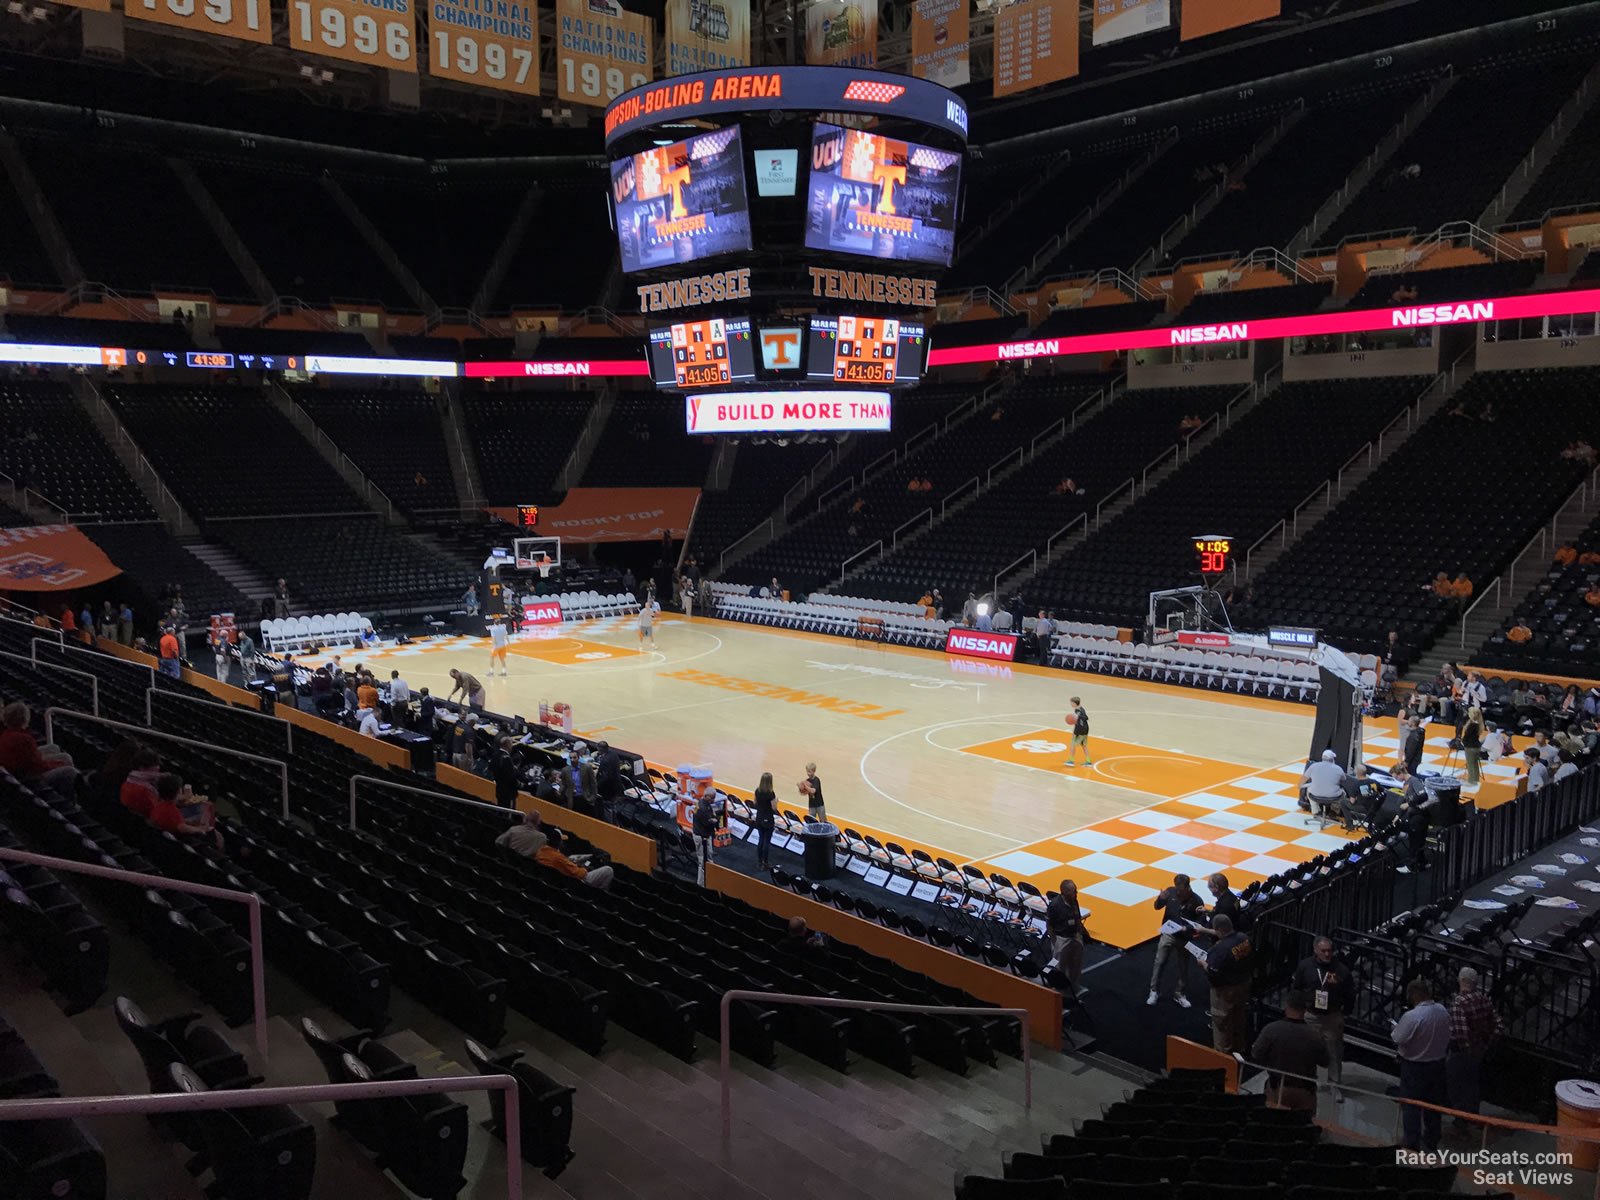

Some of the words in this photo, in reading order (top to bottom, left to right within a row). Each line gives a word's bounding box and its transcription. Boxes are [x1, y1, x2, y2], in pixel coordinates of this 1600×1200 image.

[434, 4, 532, 40] CHAMPIONS
[1536, 19, 1557, 32] 321
[296, 2, 411, 60] 1996
[562, 16, 647, 48] NATIONAL
[562, 33, 647, 64] CHAMPIONS
[435, 31, 532, 84] 1997
[1375, 56, 1393, 69] 320
[711, 74, 781, 101] ARENA
[655, 213, 707, 237] TENNESSEE
[855, 210, 914, 233] TENNESSEE
[637, 267, 751, 313] TENNESSEE
[809, 265, 937, 308] TENNESSEE
[1392, 302, 1494, 326] NISSAN
[714, 323, 722, 338] A
[842, 320, 852, 334] T
[886, 324, 894, 338] A
[1171, 323, 1248, 344] NISSAN
[674, 327, 682, 342] T
[678, 350, 684, 360] 0
[716, 346, 723, 357] 0
[763, 333, 798, 365] T
[842, 343, 849, 354] 0
[855, 348, 860, 357] 4
[873, 349, 879, 357] 4
[886, 346, 892, 357] 0
[997, 341, 1059, 359] NISSAN
[136, 351, 146, 363] 0
[194, 355, 226, 366] 41:05
[288, 357, 296, 368] 0
[690, 353, 695, 361] 4
[706, 352, 711, 360] 4
[525, 362, 590, 376] NISSAN
[688, 367, 718, 383] 41:05
[722, 372, 728, 380] 0
[837, 369, 842, 378] 0
[848, 364, 882, 379] 41:05
[887, 371, 892, 379] 0
[678, 376, 684, 384] 0
[717, 403, 774, 421] BUILD
[782, 402, 842, 420] MORE
[848, 402, 884, 419] THAN
[525, 513, 536, 525] 30
[551, 513, 622, 528] ROCKY
[622, 508, 665, 522] TOP
[1196, 541, 1230, 553] 41:05
[1202, 552, 1224, 571] 30
[489, 583, 501, 597] T
[1269, 630, 1296, 643] MUSCLE
[1296, 632, 1314, 644] MILK
[949, 635, 1013, 655] NISSAN
[656, 669, 907, 720] TENNESSEE
